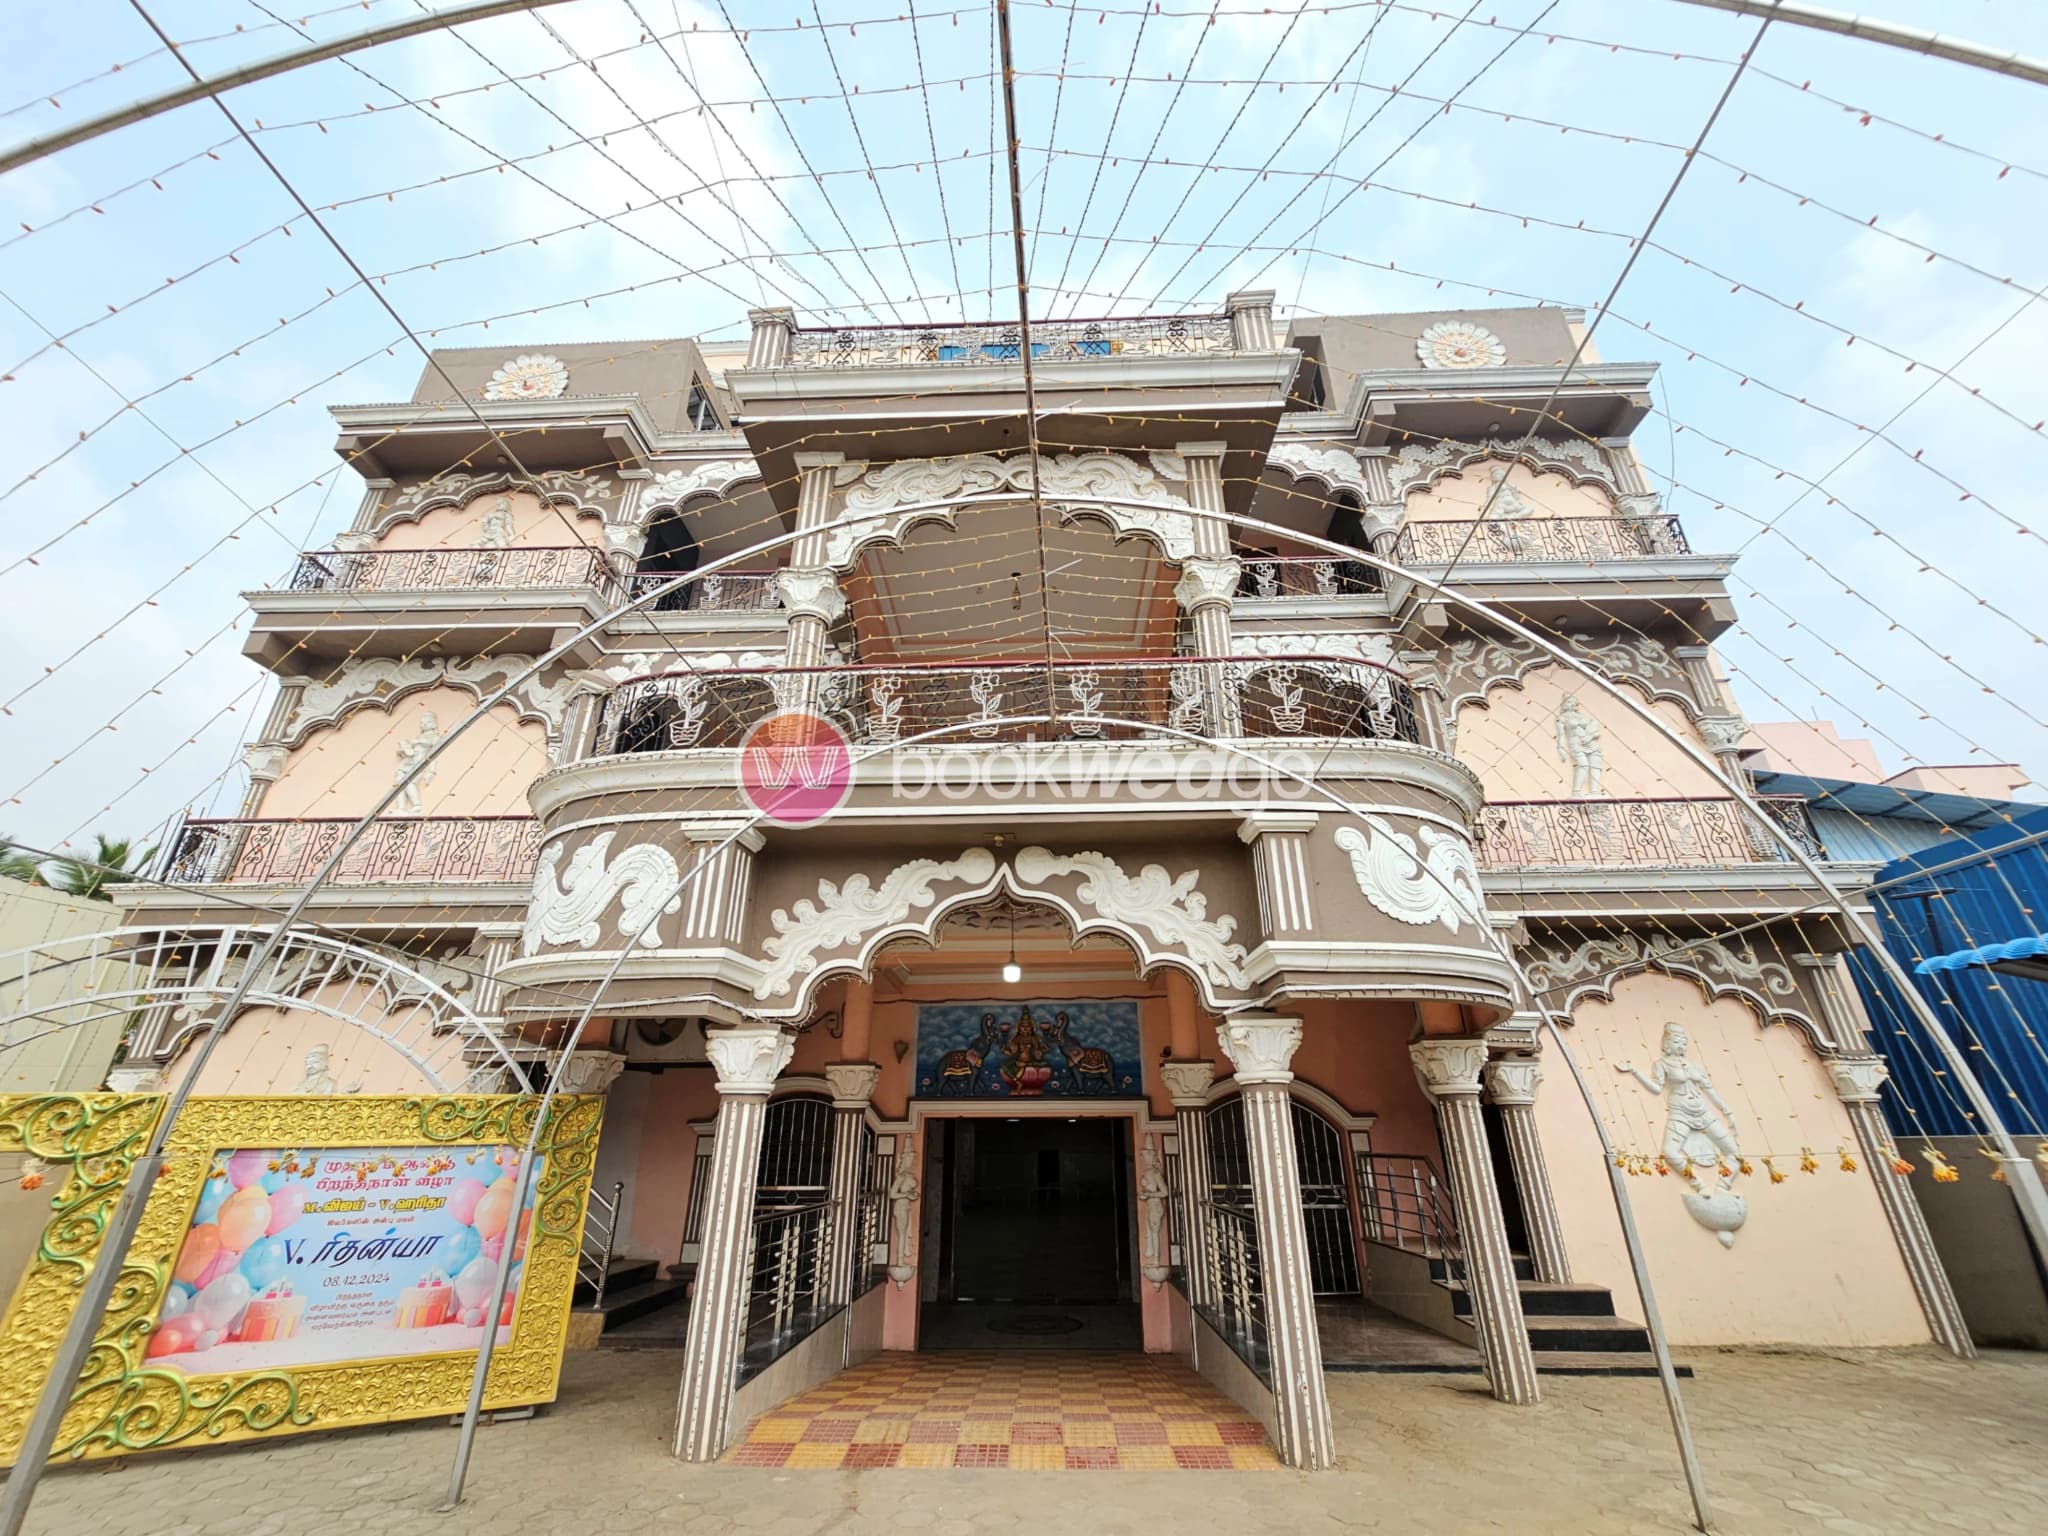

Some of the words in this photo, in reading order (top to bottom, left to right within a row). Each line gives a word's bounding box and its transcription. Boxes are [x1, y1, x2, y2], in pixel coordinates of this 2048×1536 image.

[415, 1175, 456, 1189] விழா
[306, 1227, 446, 1270] ரிதன்யா
[322, 1272, 391, 1288] 08.12.2024
